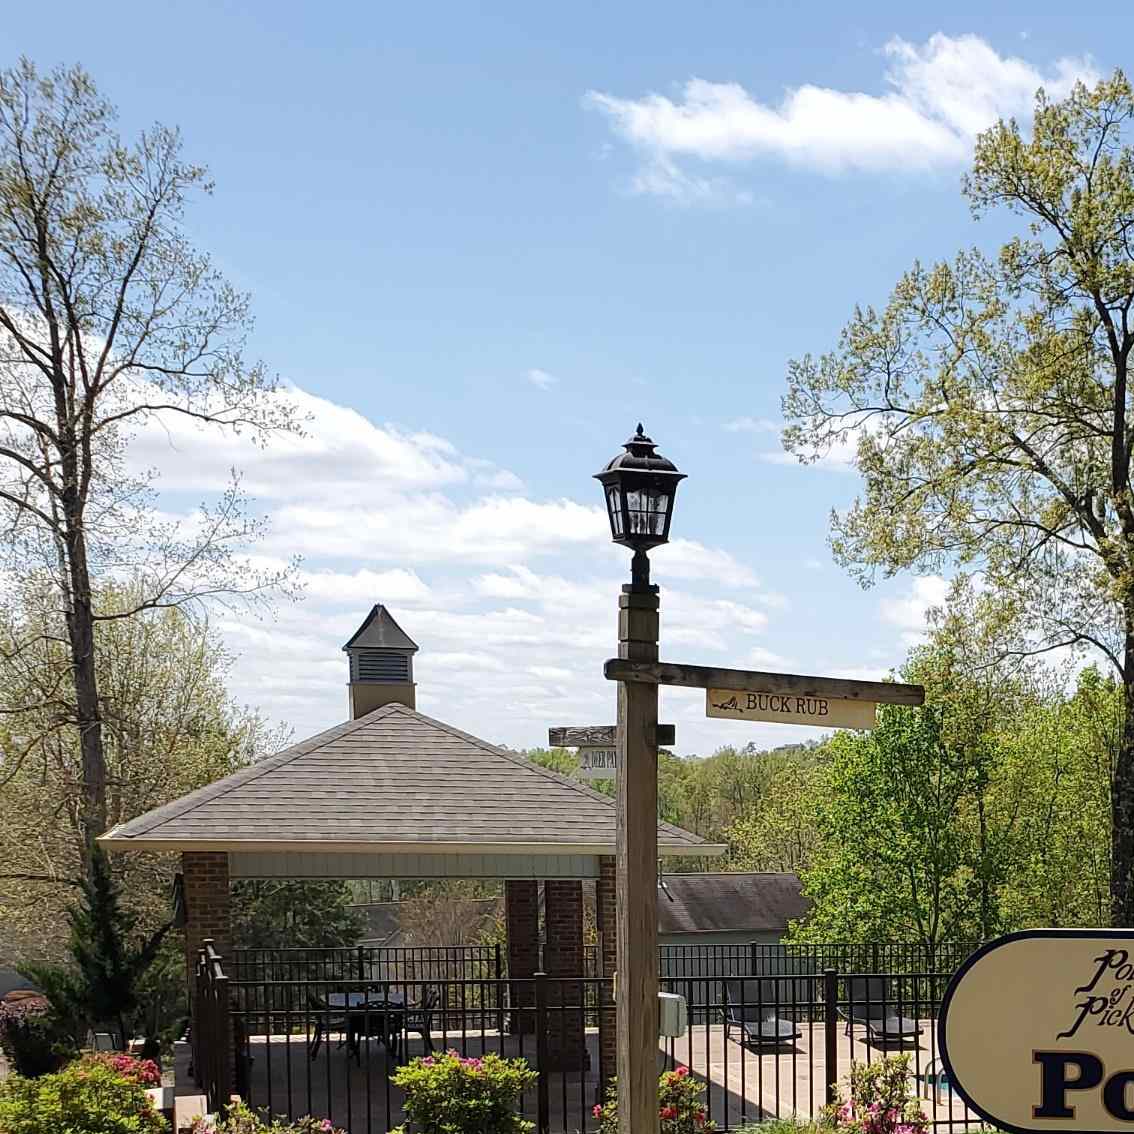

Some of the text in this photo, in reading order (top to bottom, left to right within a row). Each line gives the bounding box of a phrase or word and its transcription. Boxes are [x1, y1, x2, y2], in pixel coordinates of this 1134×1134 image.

[746, 693, 829, 716] BUCK RUB
[1110, 985, 1132, 1005] of
